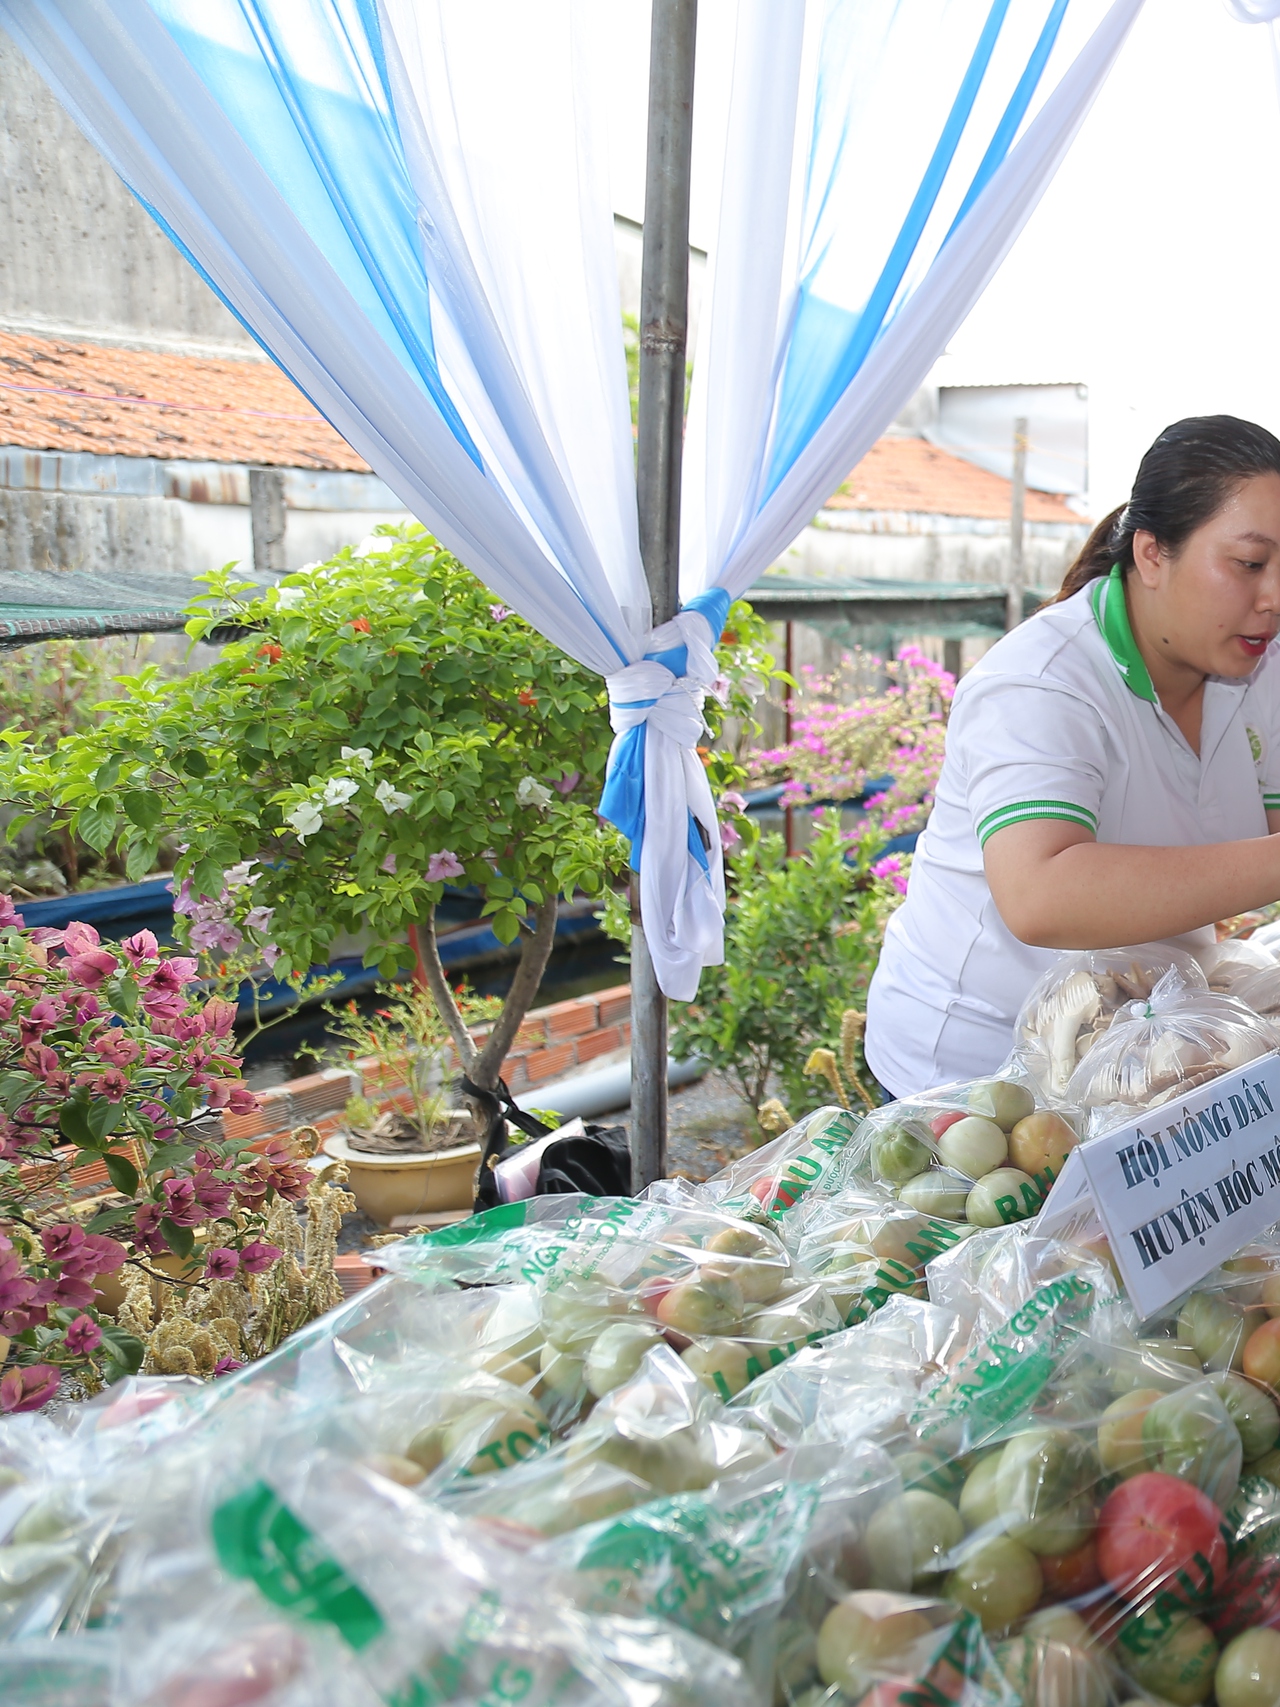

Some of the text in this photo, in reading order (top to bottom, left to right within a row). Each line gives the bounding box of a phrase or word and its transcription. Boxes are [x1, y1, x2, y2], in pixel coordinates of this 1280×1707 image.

[1116, 1078, 1275, 1190] HỘI NÔNG DÂN
[905, 1220, 962, 1266] AN
[1130, 1188, 1221, 1270] HUYỆN
[1214, 1158, 1265, 1217] HÓC
